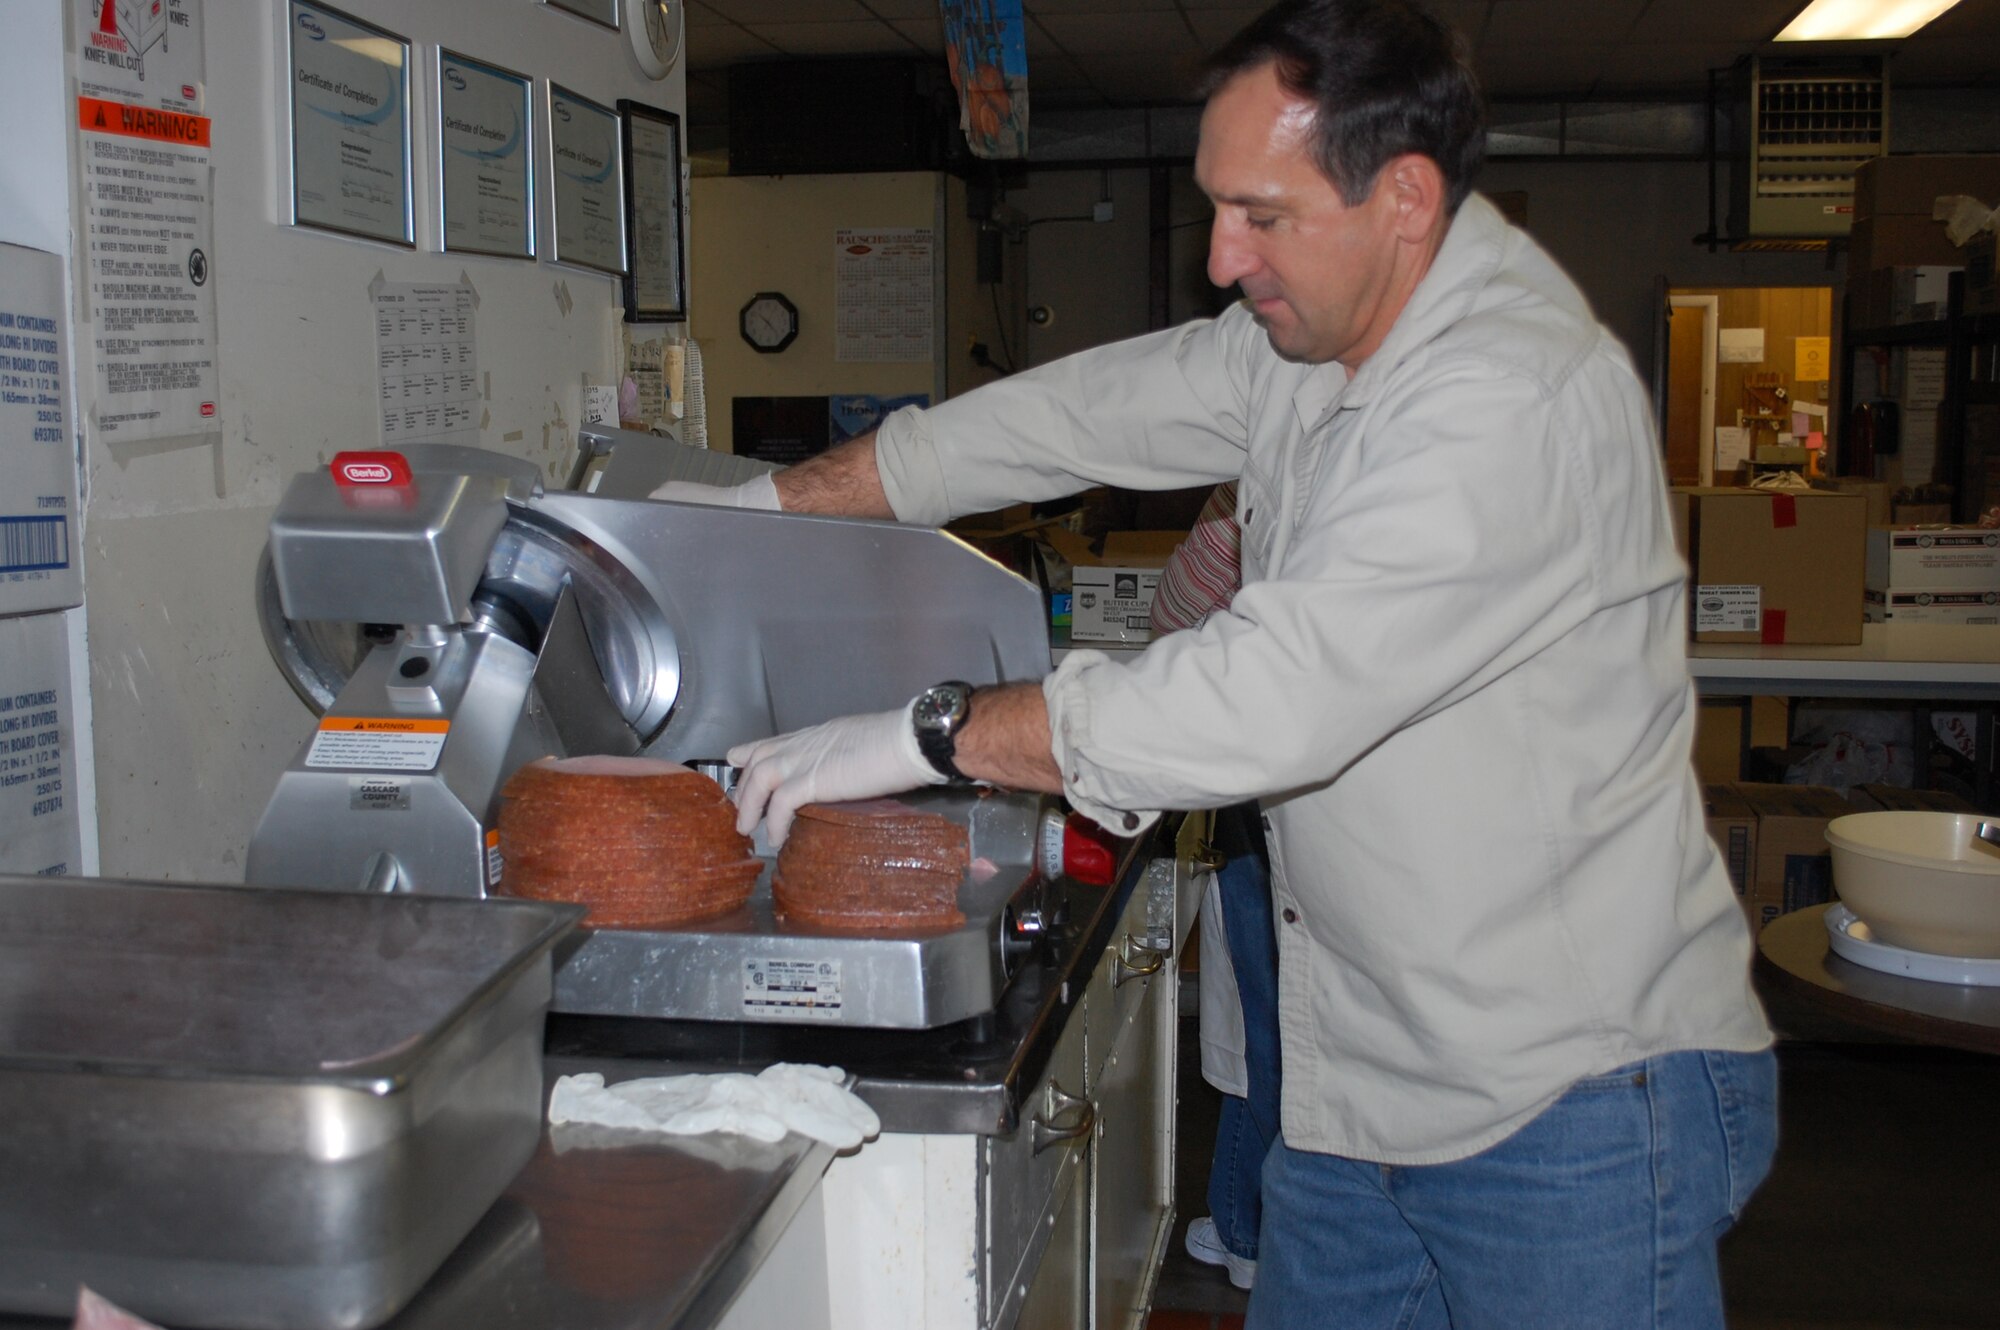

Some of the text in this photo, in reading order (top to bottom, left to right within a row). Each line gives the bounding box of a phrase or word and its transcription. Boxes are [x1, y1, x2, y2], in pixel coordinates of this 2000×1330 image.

[170, 11, 189, 27] KNIFE
[91, 32, 128, 53] WARNING
[84, 47, 142, 72] KNIFE WILL CUT
[298, 69, 378, 106] Certificate of Completion
[121, 106, 198, 141] WARNING
[446, 116, 506, 142] Certificate of Completion
[556, 144, 576, 160] Certificate
[96, 166, 121, 177] MACHINE
[100, 208, 120, 218] ALWAYS
[100, 225, 120, 235] ALWAYS
[160, 229, 170, 238] NOT
[100, 242, 153, 254] NEVER TOUCH KNIFE
[102, 259, 114, 268] KEEP
[102, 284, 149, 293] SHOULD MACHINE
[104, 308, 164, 316] TURN OFF AND UNPLUG
[17, 315, 57, 333] CONTAINERS
[23, 338, 31, 349] HI
[33, 338, 58, 354] DIVIDER
[13, 357, 36, 372] BOARD
[39, 360, 59, 375] COVER
[12, 376, 20, 387] IN
[23, 379, 27, 387] x
[30, 378, 33, 388] 1
[37, 378, 49, 390] 1/2
[53, 379, 60, 392] IN
[38, 411, 62, 423] 250/CS
[35, 428, 63, 442] 6937874
[350, 468, 385, 478] Berkel
[15, 690, 57, 710] CONTAINERS
[22, 715, 30, 730] HI
[32, 710, 58, 728] DIVIDER
[368, 722, 415, 730] WARNING
[12, 735, 36, 752] BOARD
[38, 730, 59, 746] COVER
[11, 756, 19, 768] IN
[22, 759, 26, 767] x
[29, 755, 33, 764] 1
[36, 751, 48, 764] 1/2
[52, 748, 60, 760] IN
[1, 772, 28, 787] 165mm
[30, 772, 35, 780] x
[37, 780, 62, 796] 250/CS
[360, 785, 400, 793] CASCADE
[33, 796, 62, 817] 6937874
